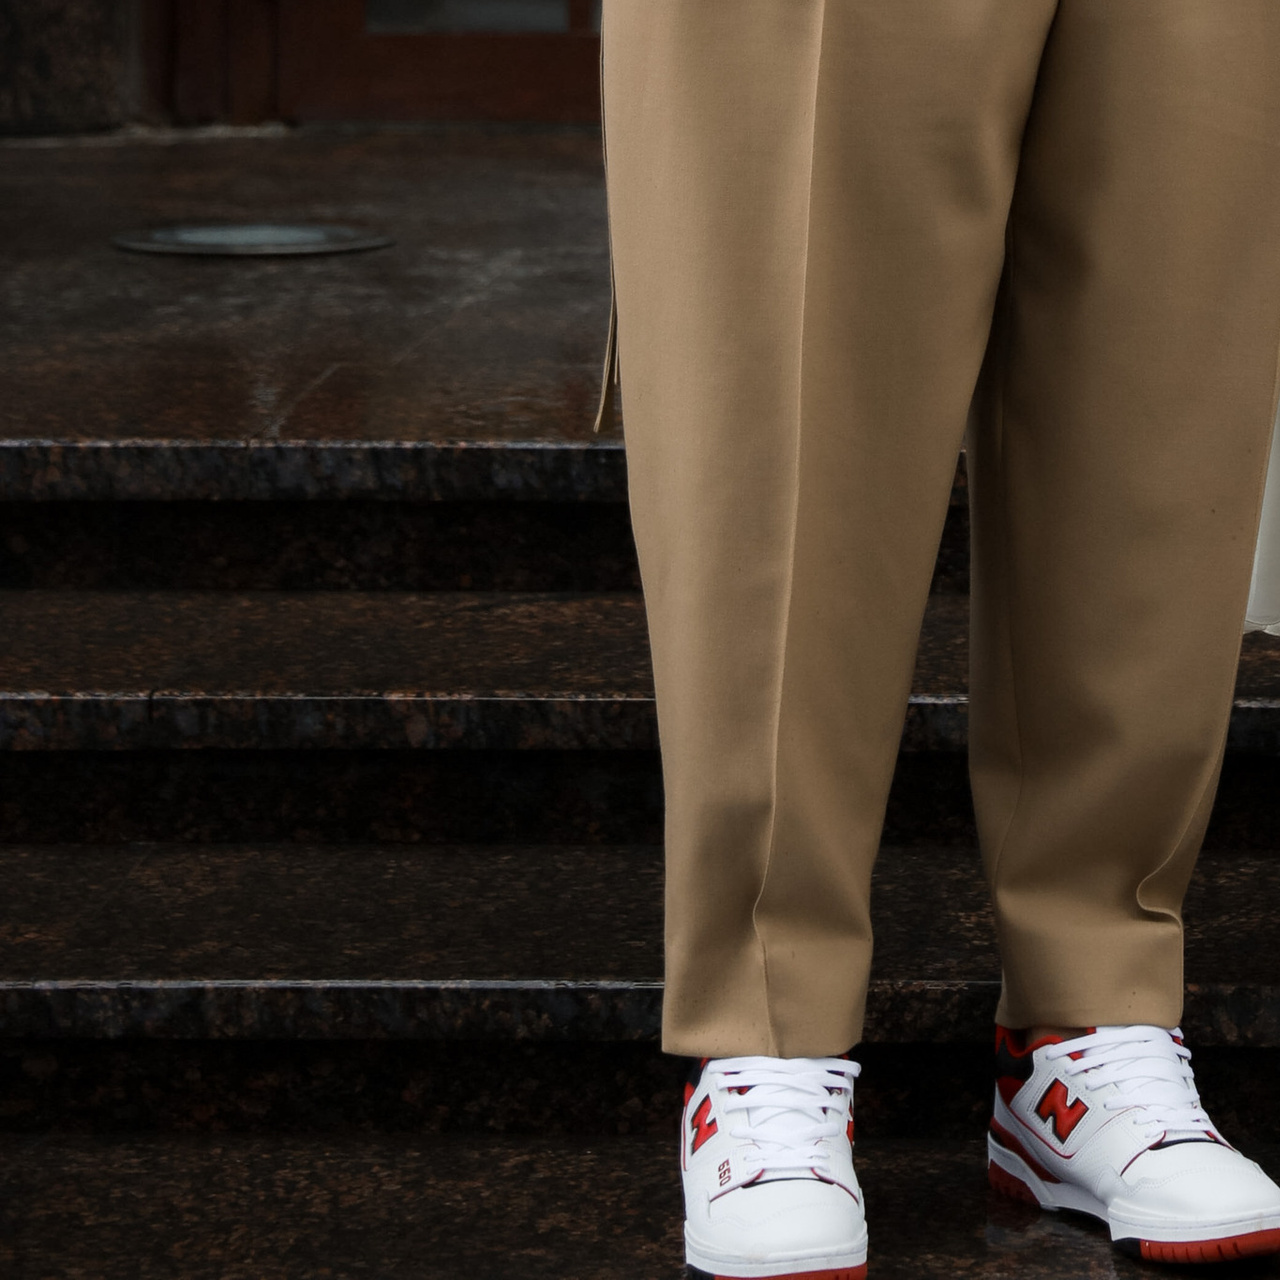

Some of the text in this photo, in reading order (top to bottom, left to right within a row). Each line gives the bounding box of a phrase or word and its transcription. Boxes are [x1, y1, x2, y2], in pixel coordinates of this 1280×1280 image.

[691, 1094, 718, 1156] N
[1034, 1077, 1089, 1145] N
[718, 1158, 731, 1187] 550
